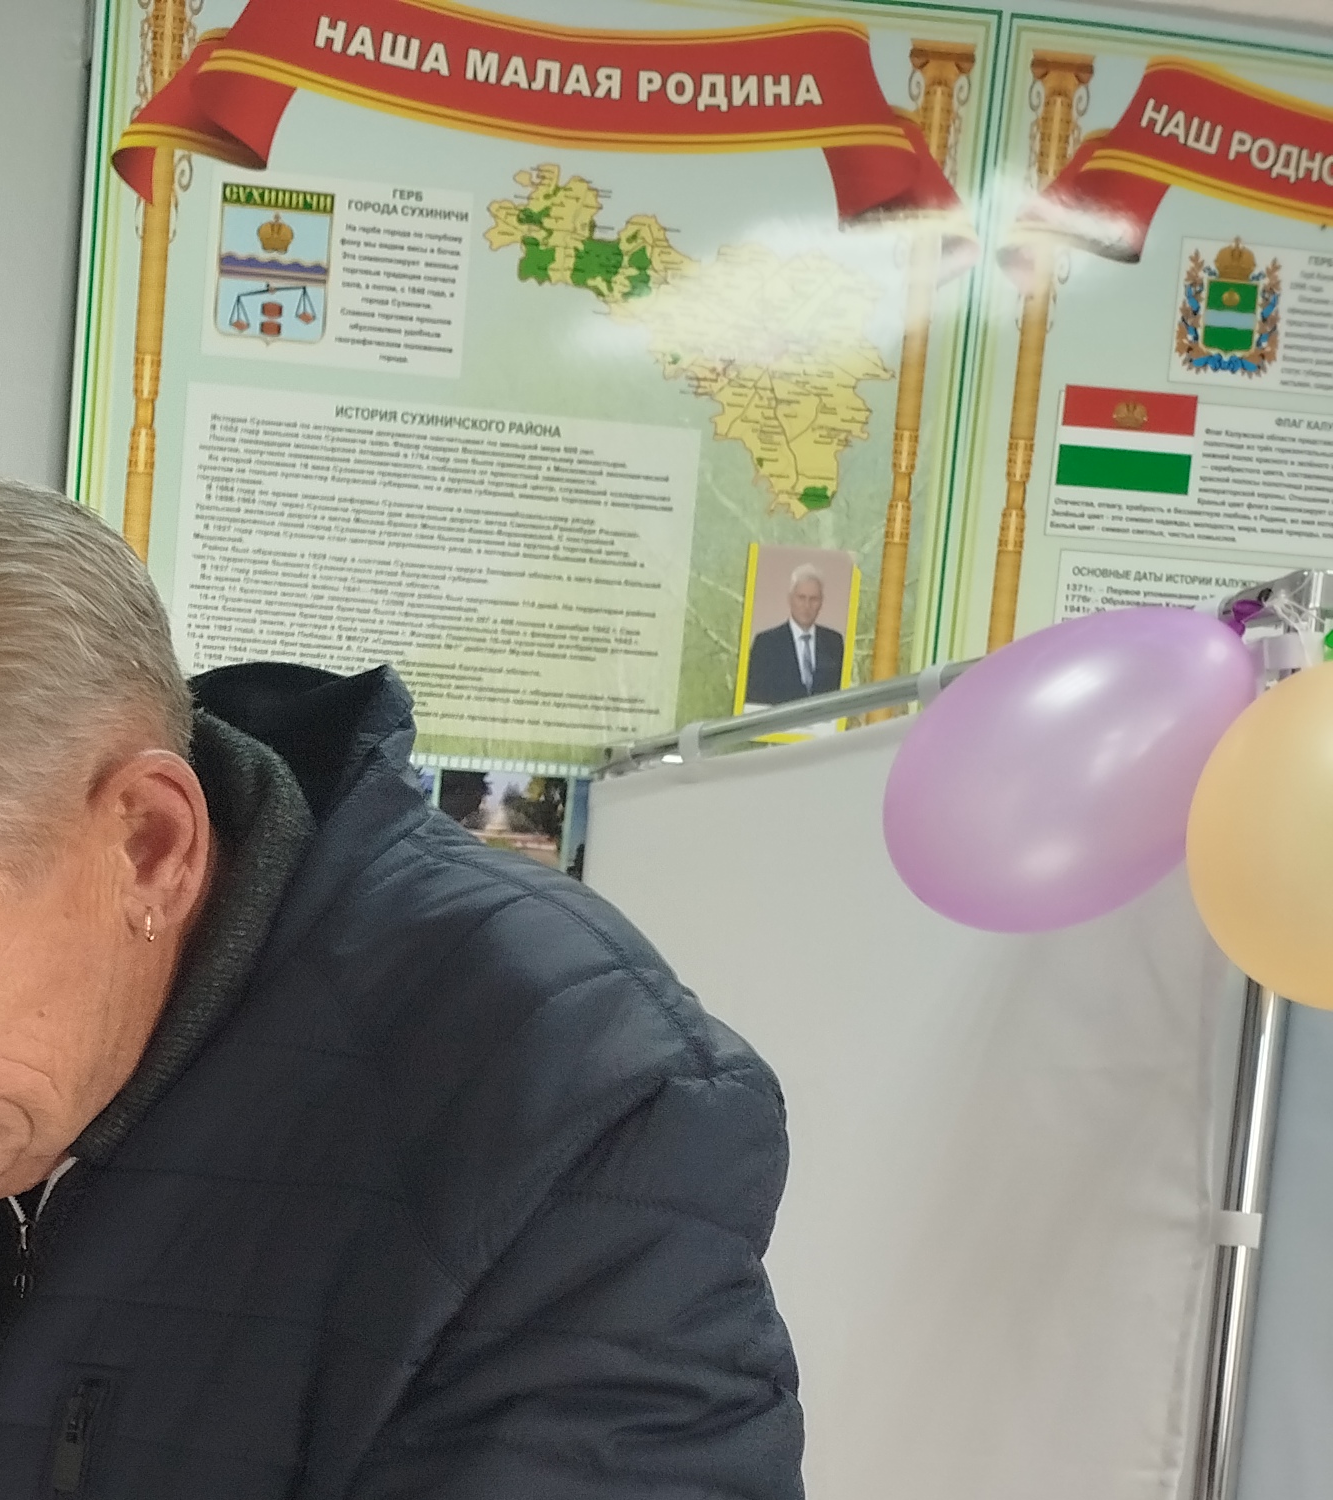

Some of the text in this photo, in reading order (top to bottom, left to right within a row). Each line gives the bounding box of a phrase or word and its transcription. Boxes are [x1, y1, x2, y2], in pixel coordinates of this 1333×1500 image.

[314, 15, 823, 112] НАША МАЛАЯ РОДИНА
[1140, 97, 1223, 155] НАШ
[392, 188, 423, 202] ГЕРБ
[347, 199, 469, 222] ГОРОДА СУХИНИЧИ
[335, 404, 562, 439] ИСТОРИЯ СУХИНИЧСКОГО РАЙОНА
[1275, 417, 1304, 428] ФЛАГ
[1072, 565, 1131, 581] ОСНОВНЫЕ
[1133, 571, 1163, 583] ДАТЫ
[1165, 573, 1212, 586] ИСТОРИИ
